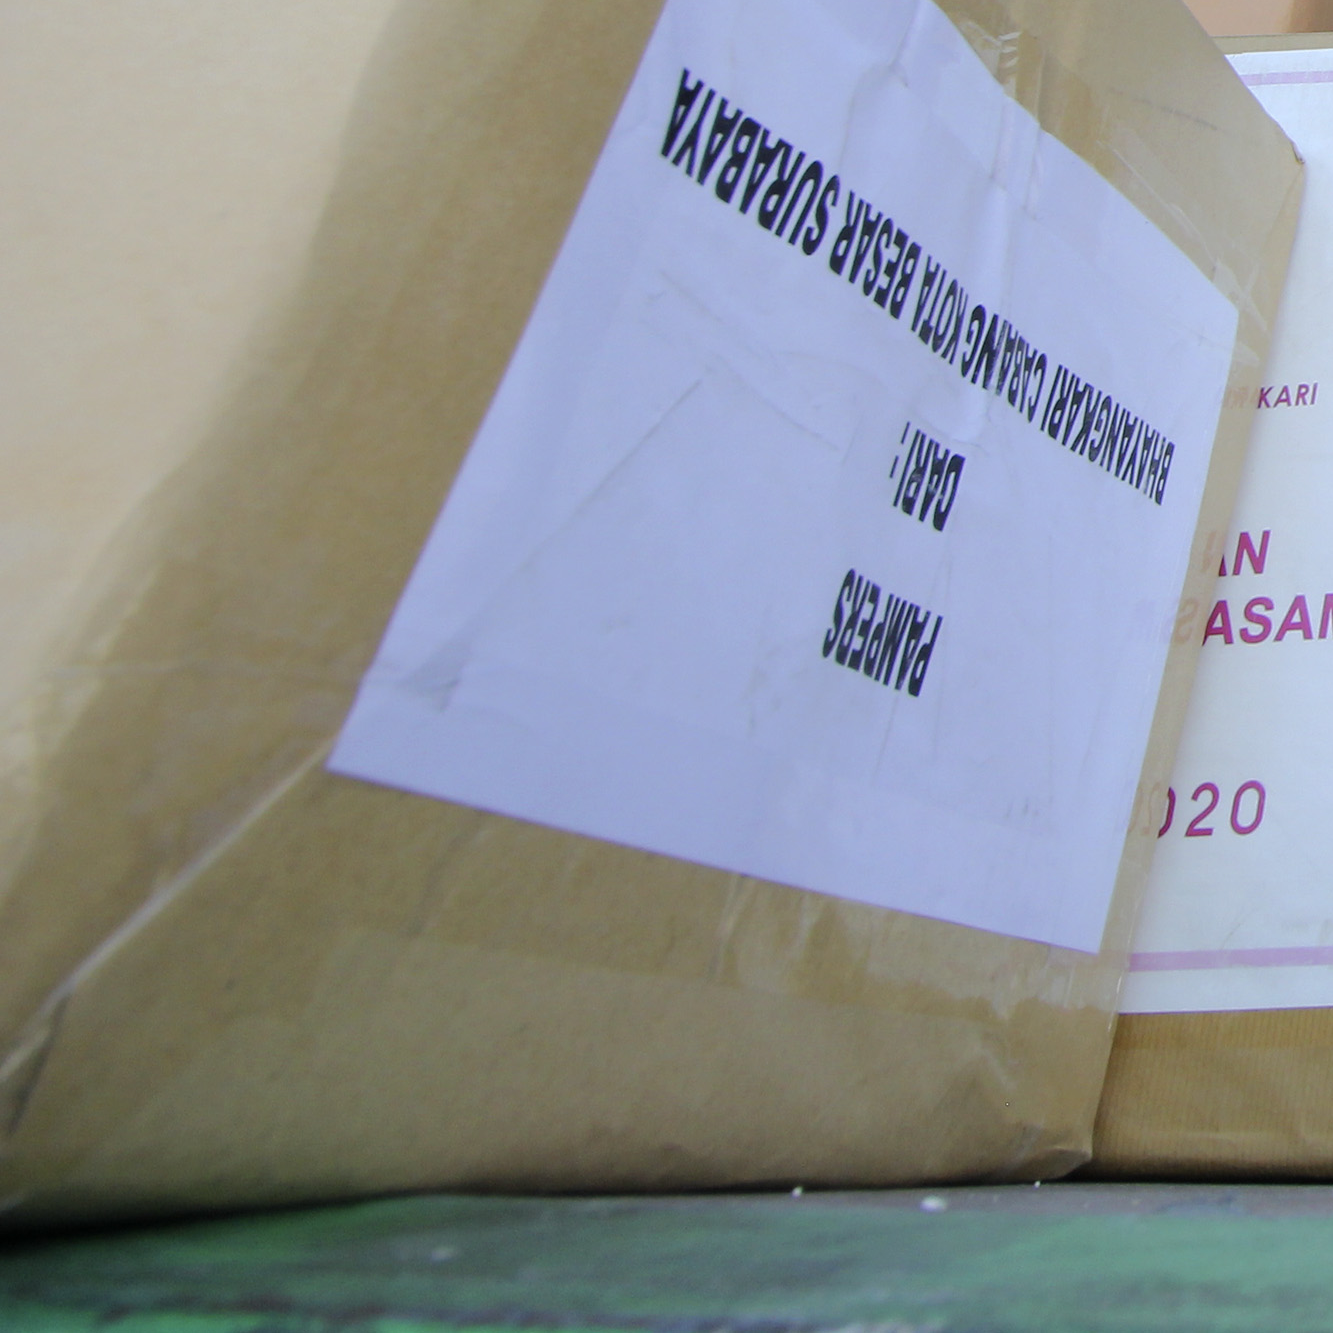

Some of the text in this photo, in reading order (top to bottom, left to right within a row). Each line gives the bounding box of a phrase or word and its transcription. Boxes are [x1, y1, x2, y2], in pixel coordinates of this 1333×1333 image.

[661, 68, 1175, 506] BHAYANGKARI CABANG KOTA BESAR SURABAYA
[822, 568, 943, 698] PAMPERS
